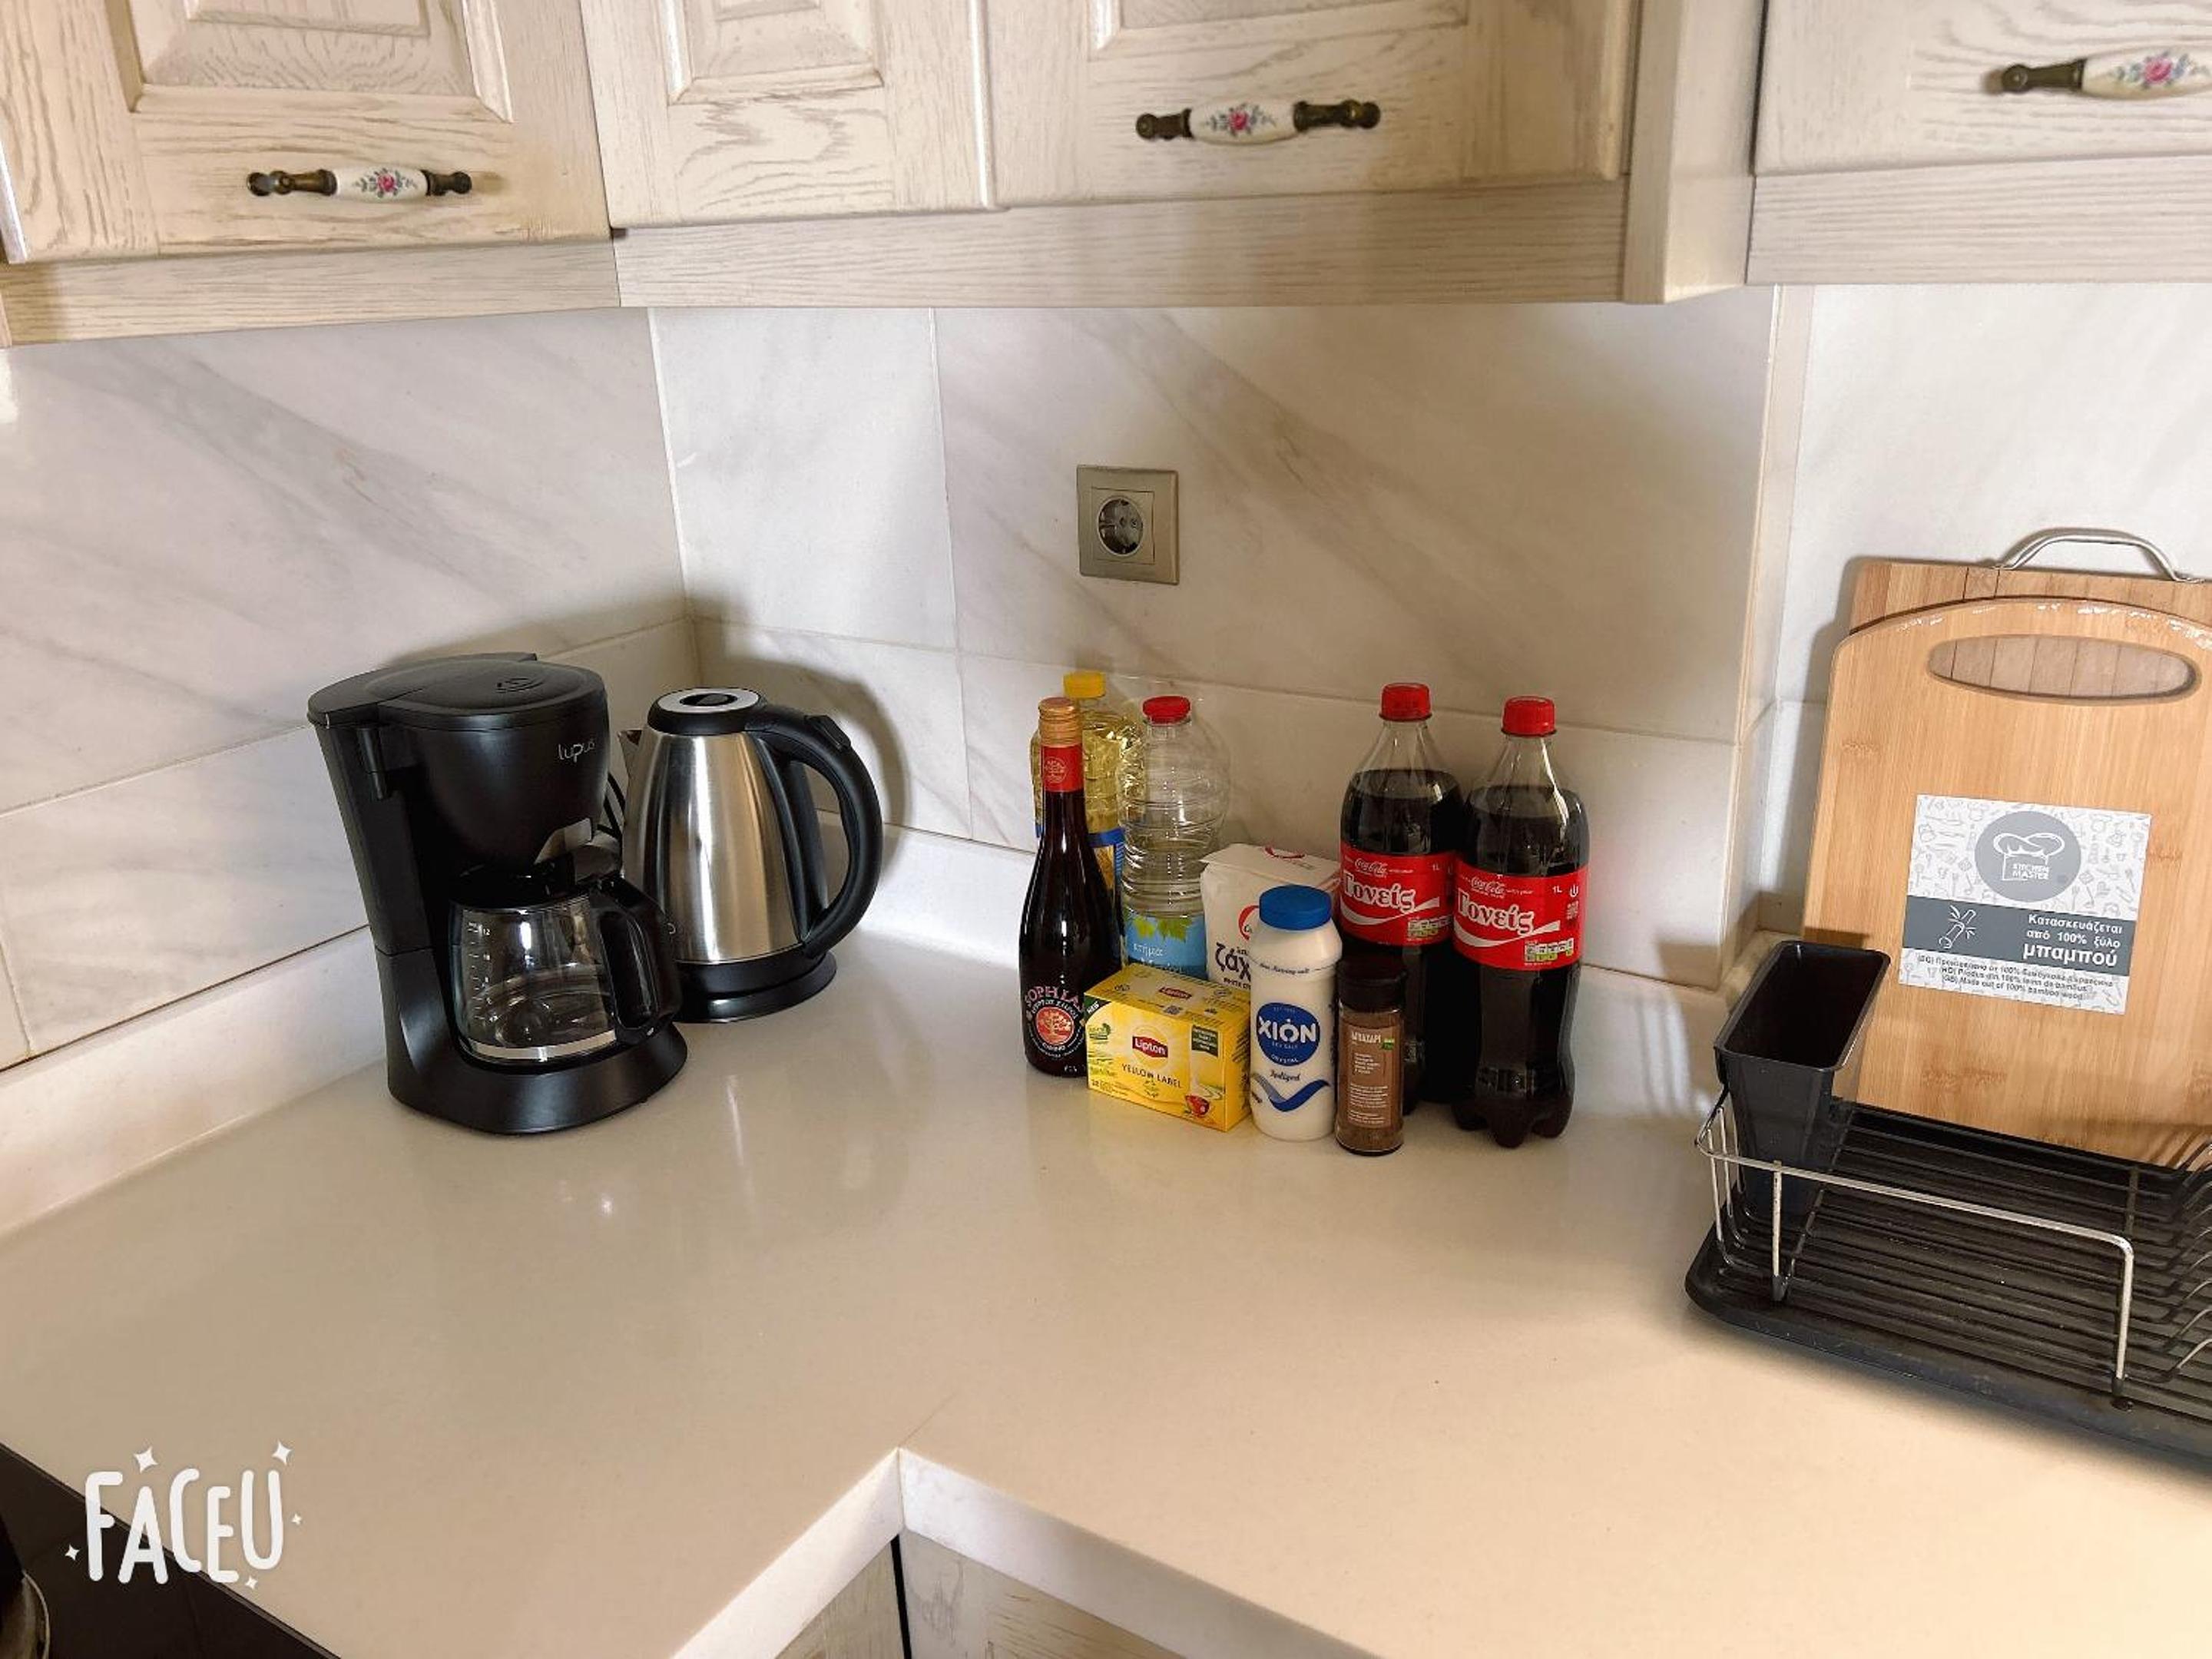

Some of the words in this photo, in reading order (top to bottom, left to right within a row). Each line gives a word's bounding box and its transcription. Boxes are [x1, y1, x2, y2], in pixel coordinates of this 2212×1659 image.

[2028, 914, 2123, 934] Κατασκευάζεται
[2026, 929, 2051, 940] από
[2058, 932, 2088, 945] 100%
[2094, 935, 2121, 949] ξύλο
[2022, 943, 2118, 967] μπαμπού
[1134, 1038, 1166, 1055] Lipton
[1121, 1063, 1154, 1078] YELLOW
[1157, 1074, 1183, 1088] LABEL
